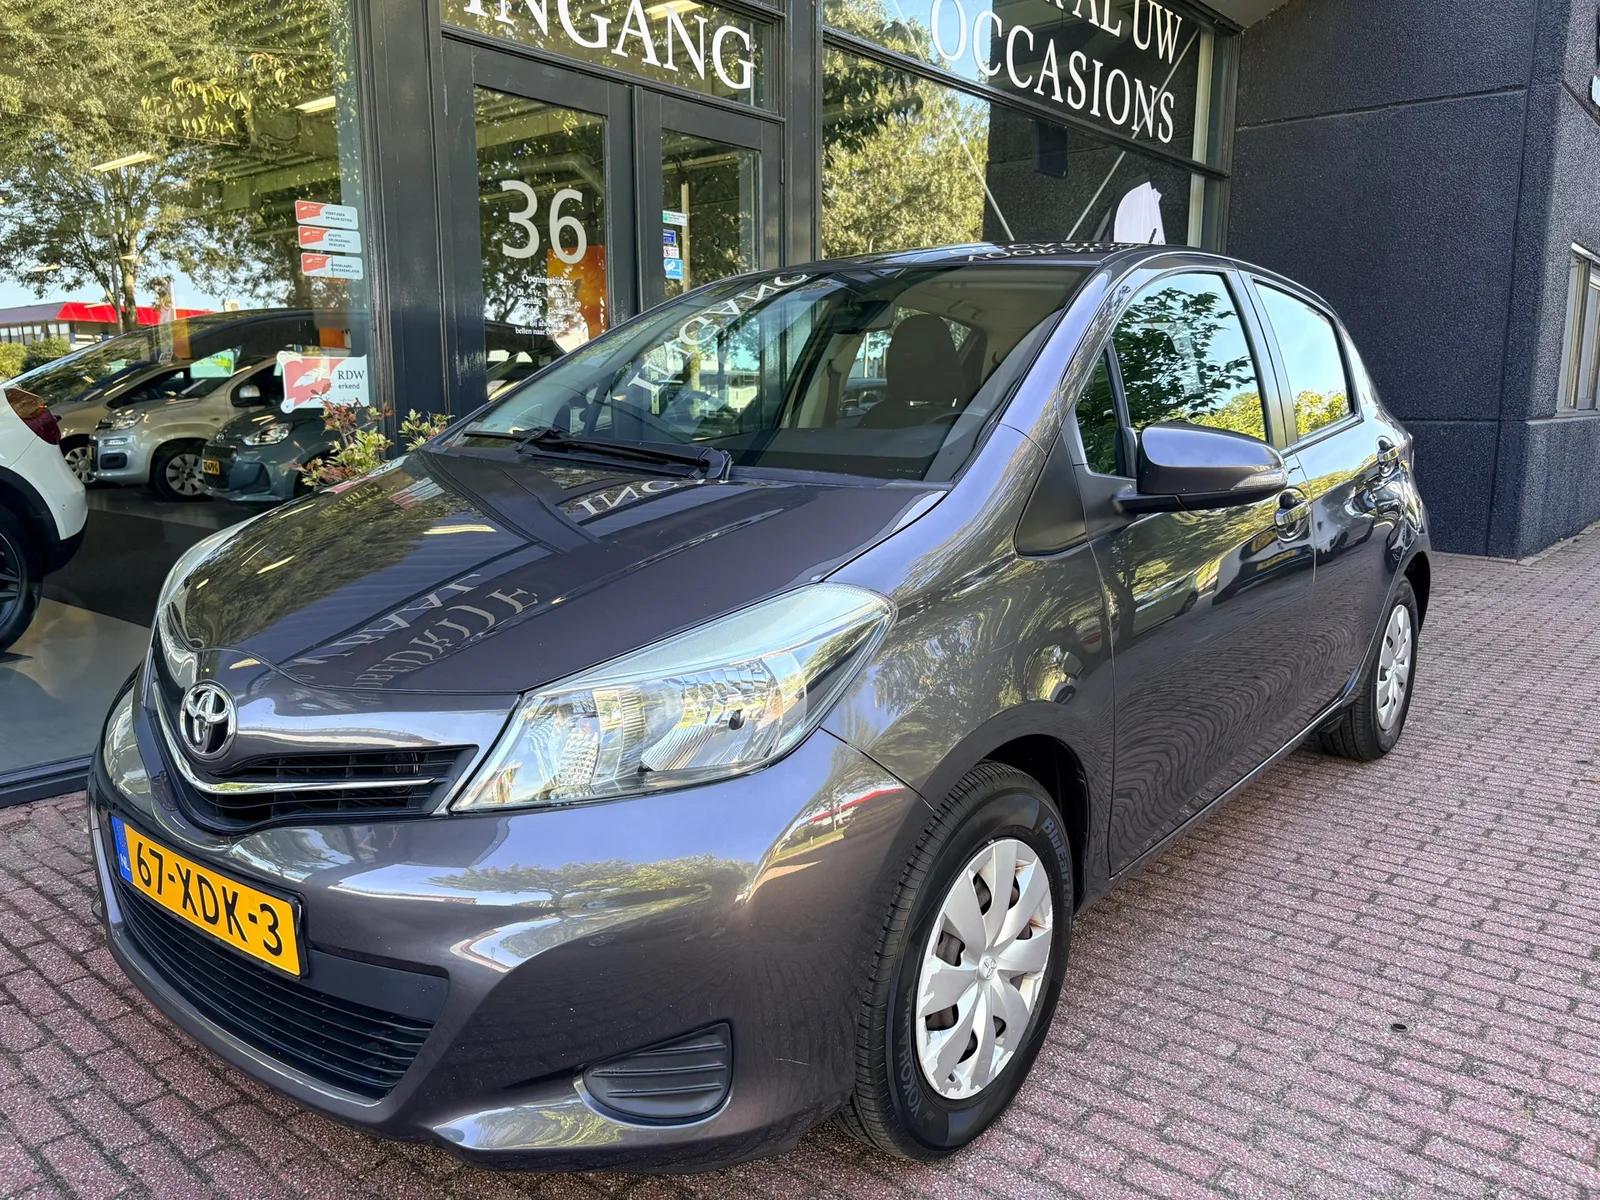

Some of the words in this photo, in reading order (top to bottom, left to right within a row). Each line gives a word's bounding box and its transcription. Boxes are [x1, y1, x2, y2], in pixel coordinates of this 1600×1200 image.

[464, 0, 755, 90] GANG
[1133, 0, 1183, 64] UW
[931, 0, 1175, 144] OCCASIONS
[500, 179, 588, 265] 36
[522, 274, 573, 286] Openingstijden:
[337, 370, 365, 380] RDW
[338, 382, 360, 390] erkend
[119, 852, 131, 872] NL
[137, 841, 283, 957] 67-XDK-3
